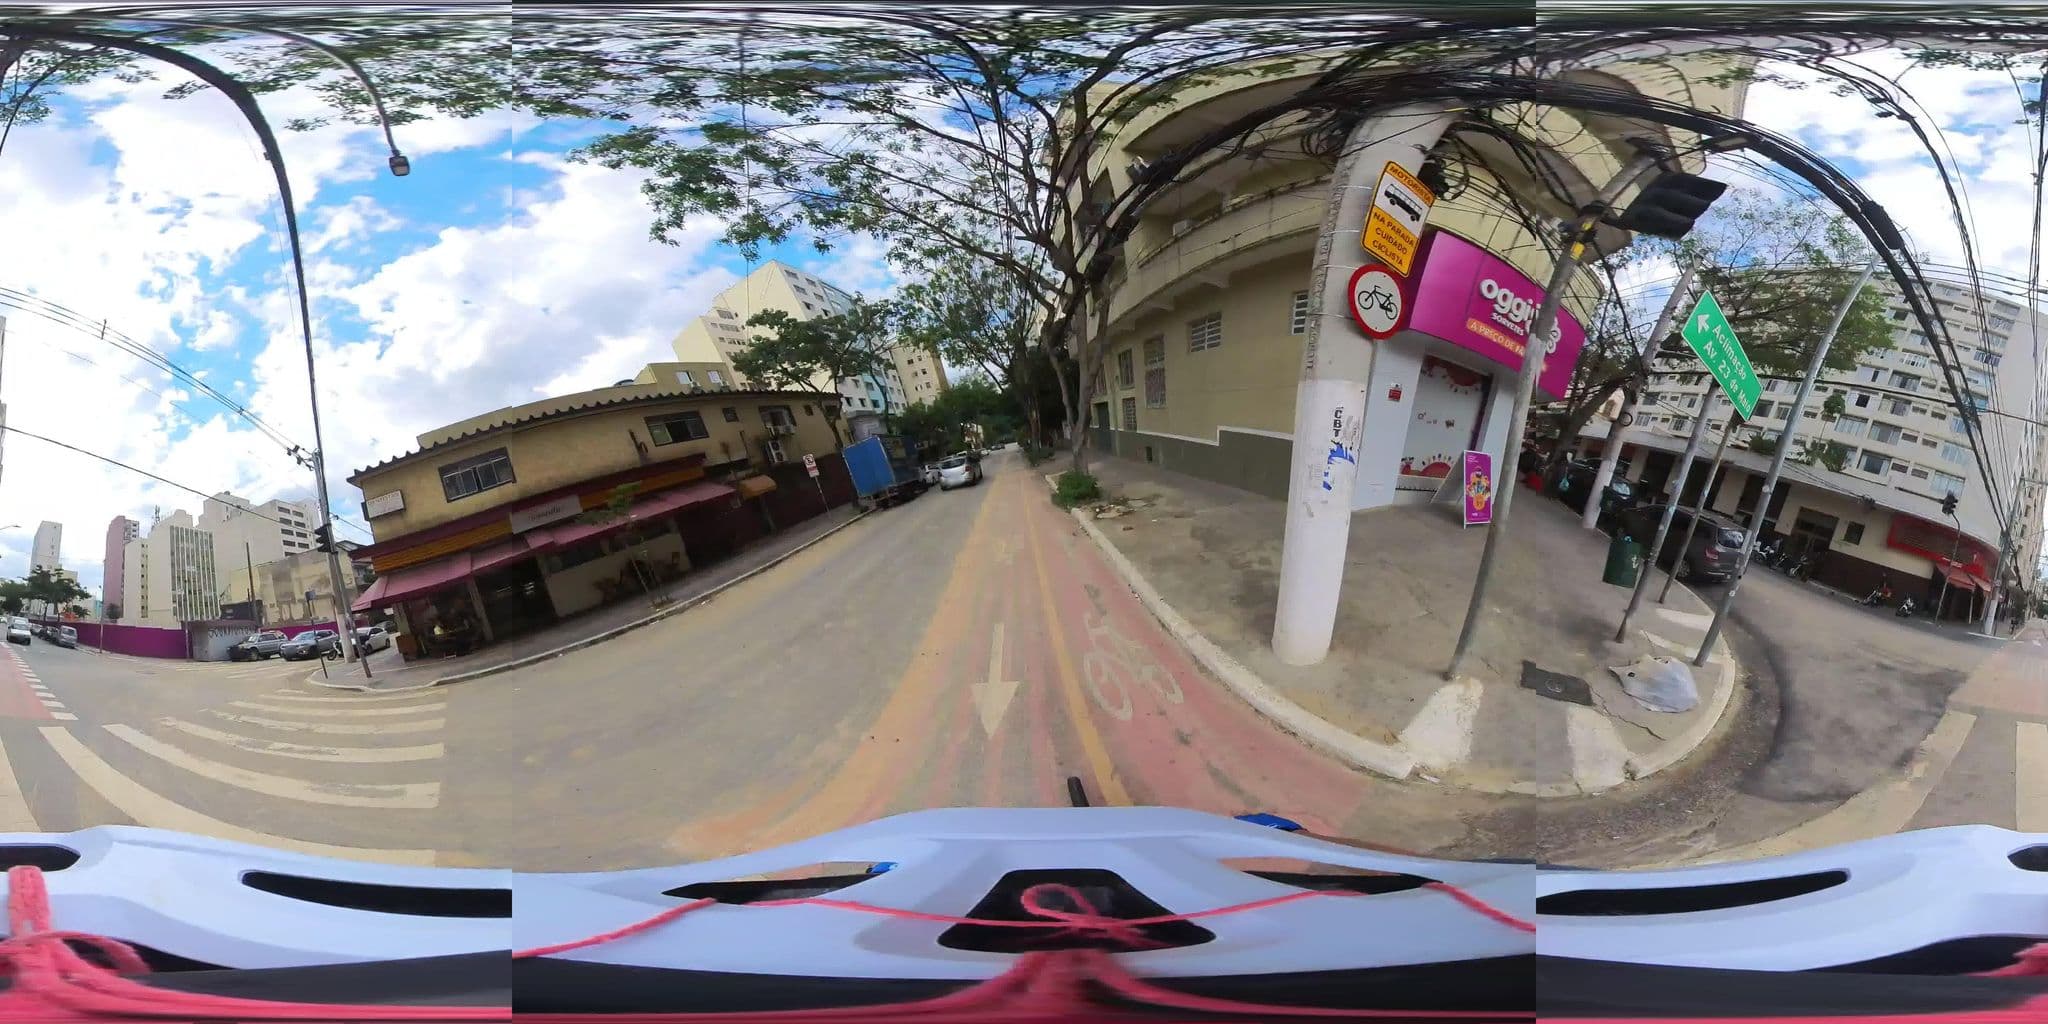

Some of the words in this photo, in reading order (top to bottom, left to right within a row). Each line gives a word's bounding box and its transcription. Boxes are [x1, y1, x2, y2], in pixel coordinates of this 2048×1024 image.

[1390, 166, 1432, 202] MOTORISTA
[1373, 212, 1386, 224] NA
[1387, 221, 1414, 247] PARADA
[1375, 227, 1408, 255] CUIDADO
[1372, 239, 1404, 266] CICLISTA
[1712, 324, 1747, 380] Aclimação
[1703, 340, 1717, 364] Av.
[1718, 359, 1731, 379] 23
[1729, 378, 1739, 393] de
[1737, 389, 1752, 413] Maio
